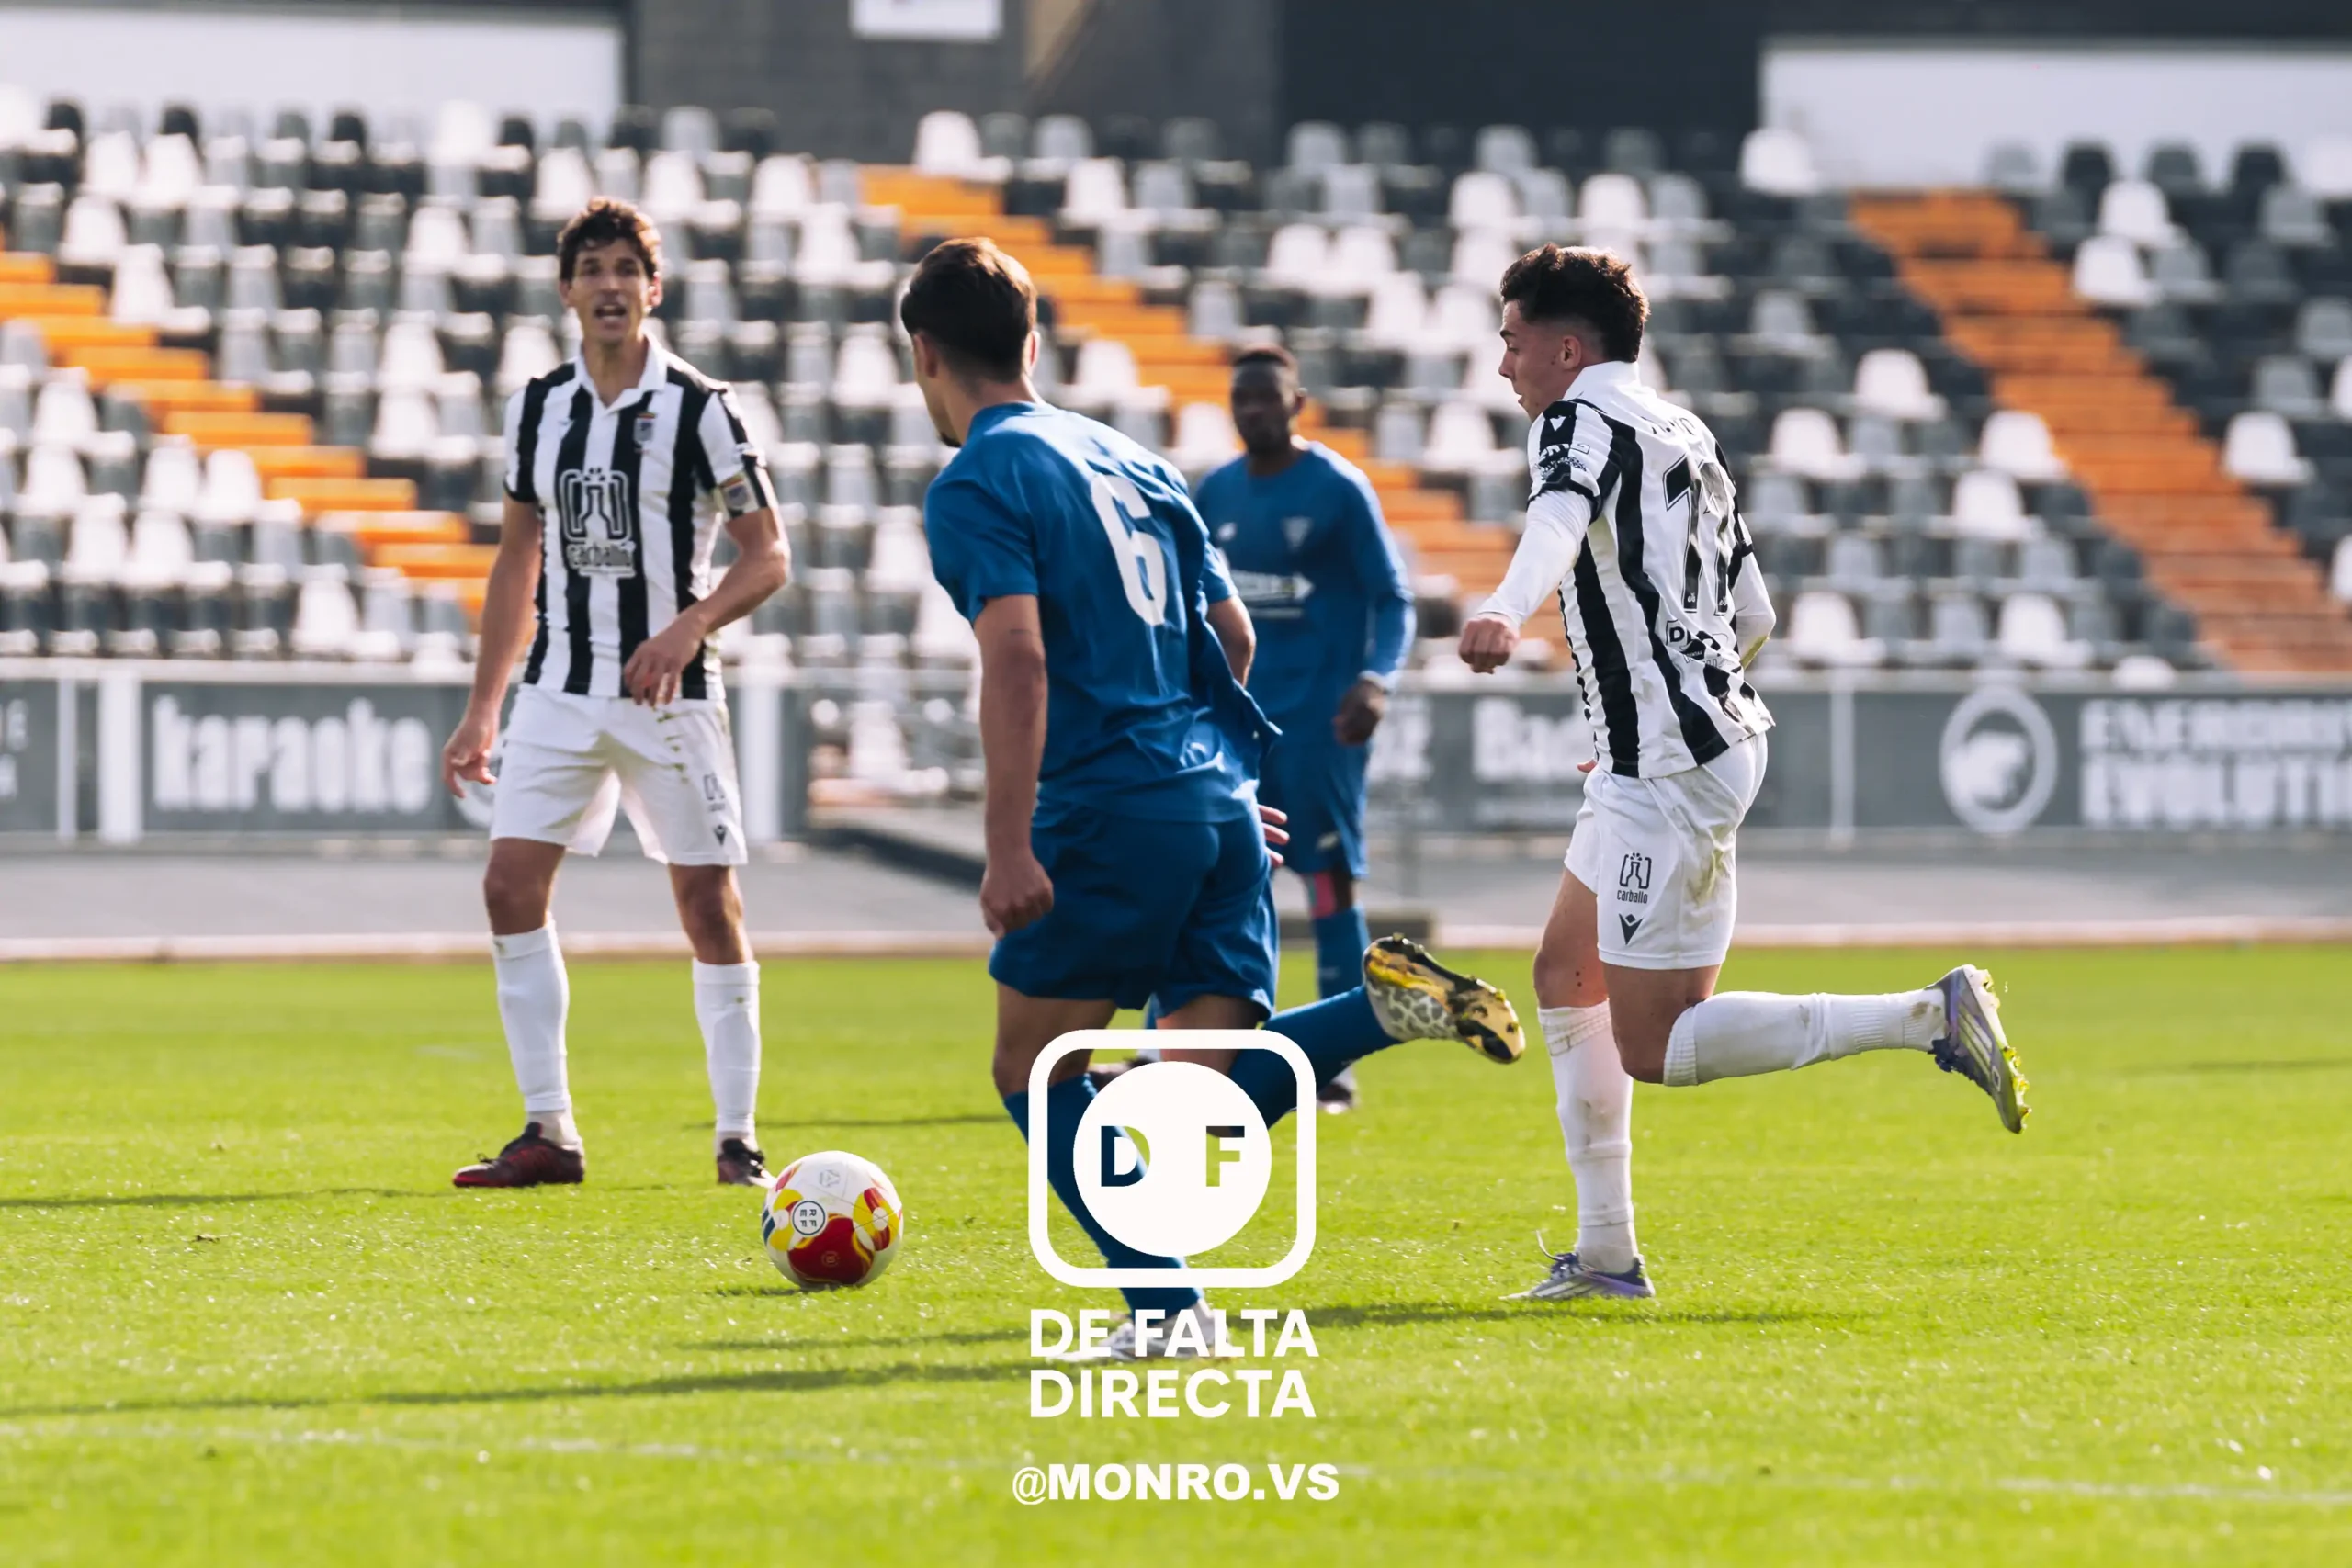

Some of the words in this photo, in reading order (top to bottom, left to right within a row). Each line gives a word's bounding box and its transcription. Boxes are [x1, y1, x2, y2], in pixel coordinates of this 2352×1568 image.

[1091, 473, 1167, 626] 6
[153, 694, 432, 813] karaoke
[1616, 889, 1648, 904] carballo
